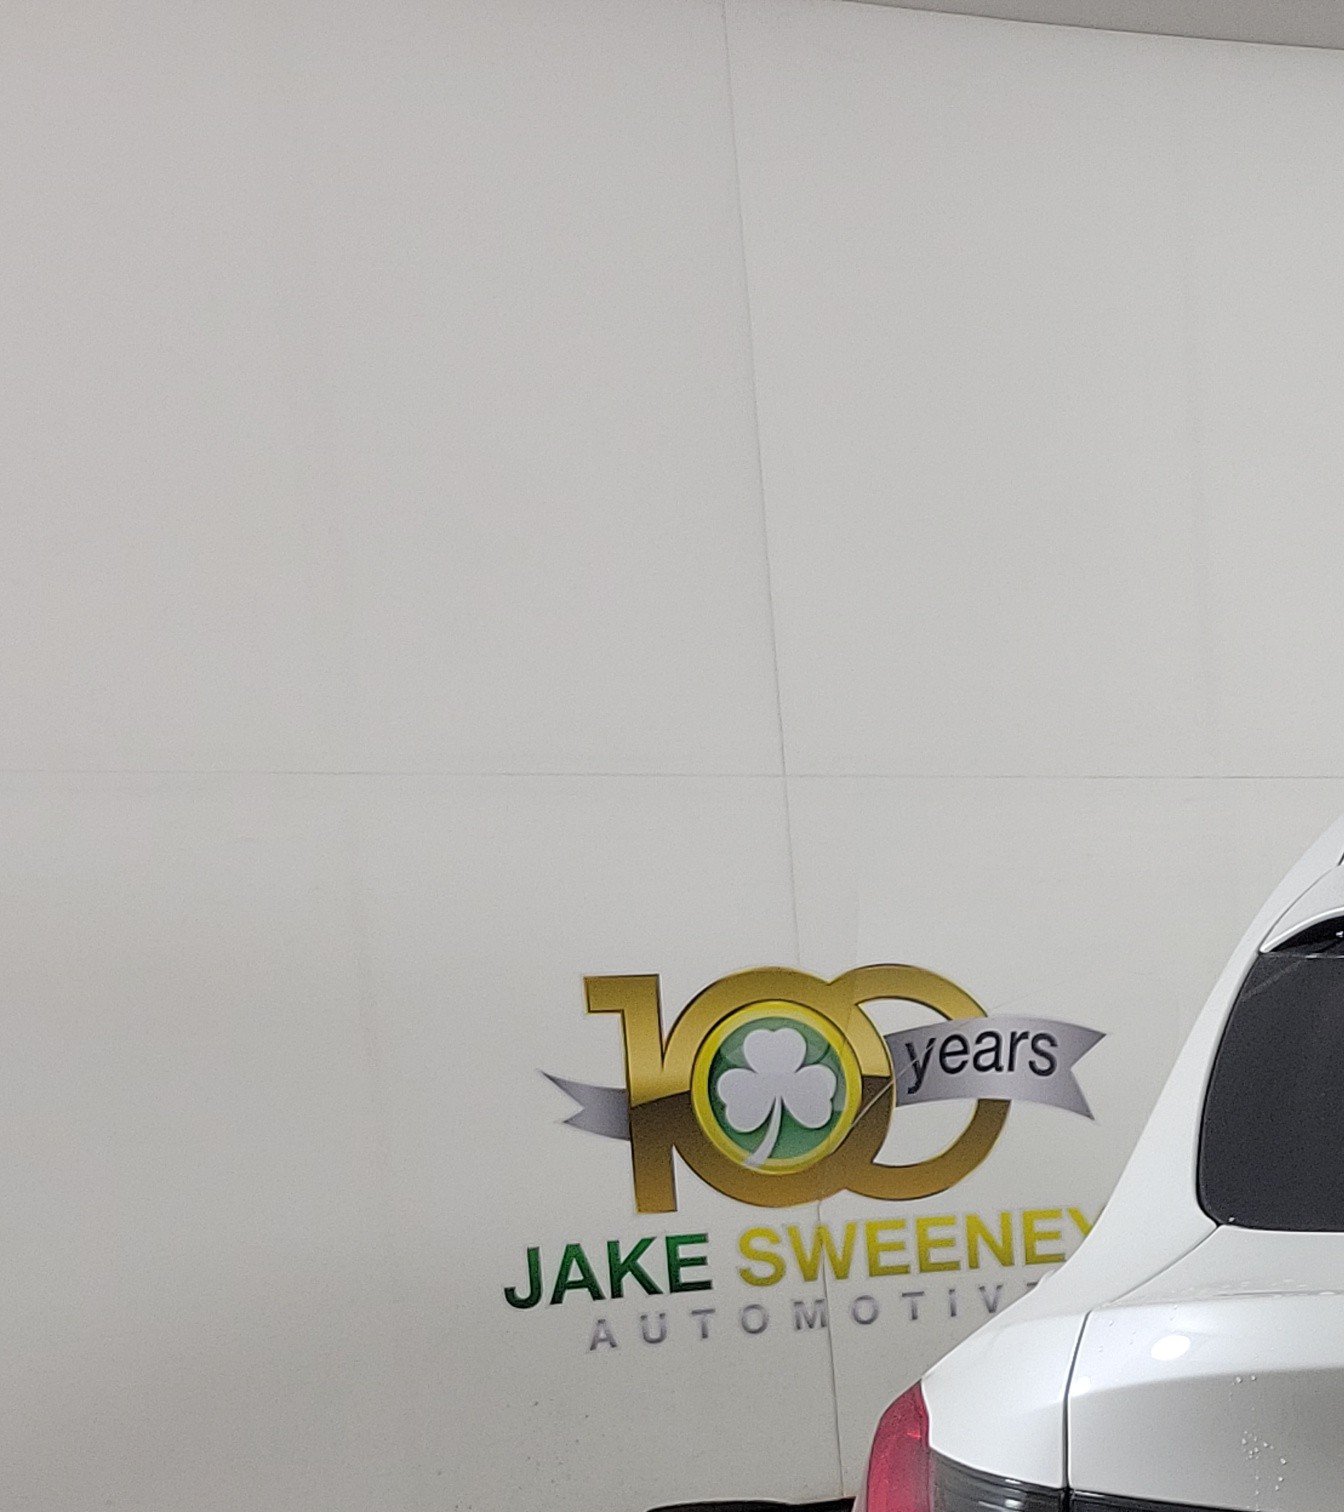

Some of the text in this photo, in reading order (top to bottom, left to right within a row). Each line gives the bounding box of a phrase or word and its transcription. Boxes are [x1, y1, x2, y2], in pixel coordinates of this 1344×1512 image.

[583, 963, 1058, 1214] 100 years
[503, 1232, 713, 1310] JAKE
[589, 1281, 1039, 1352] AUTOMOTIV
